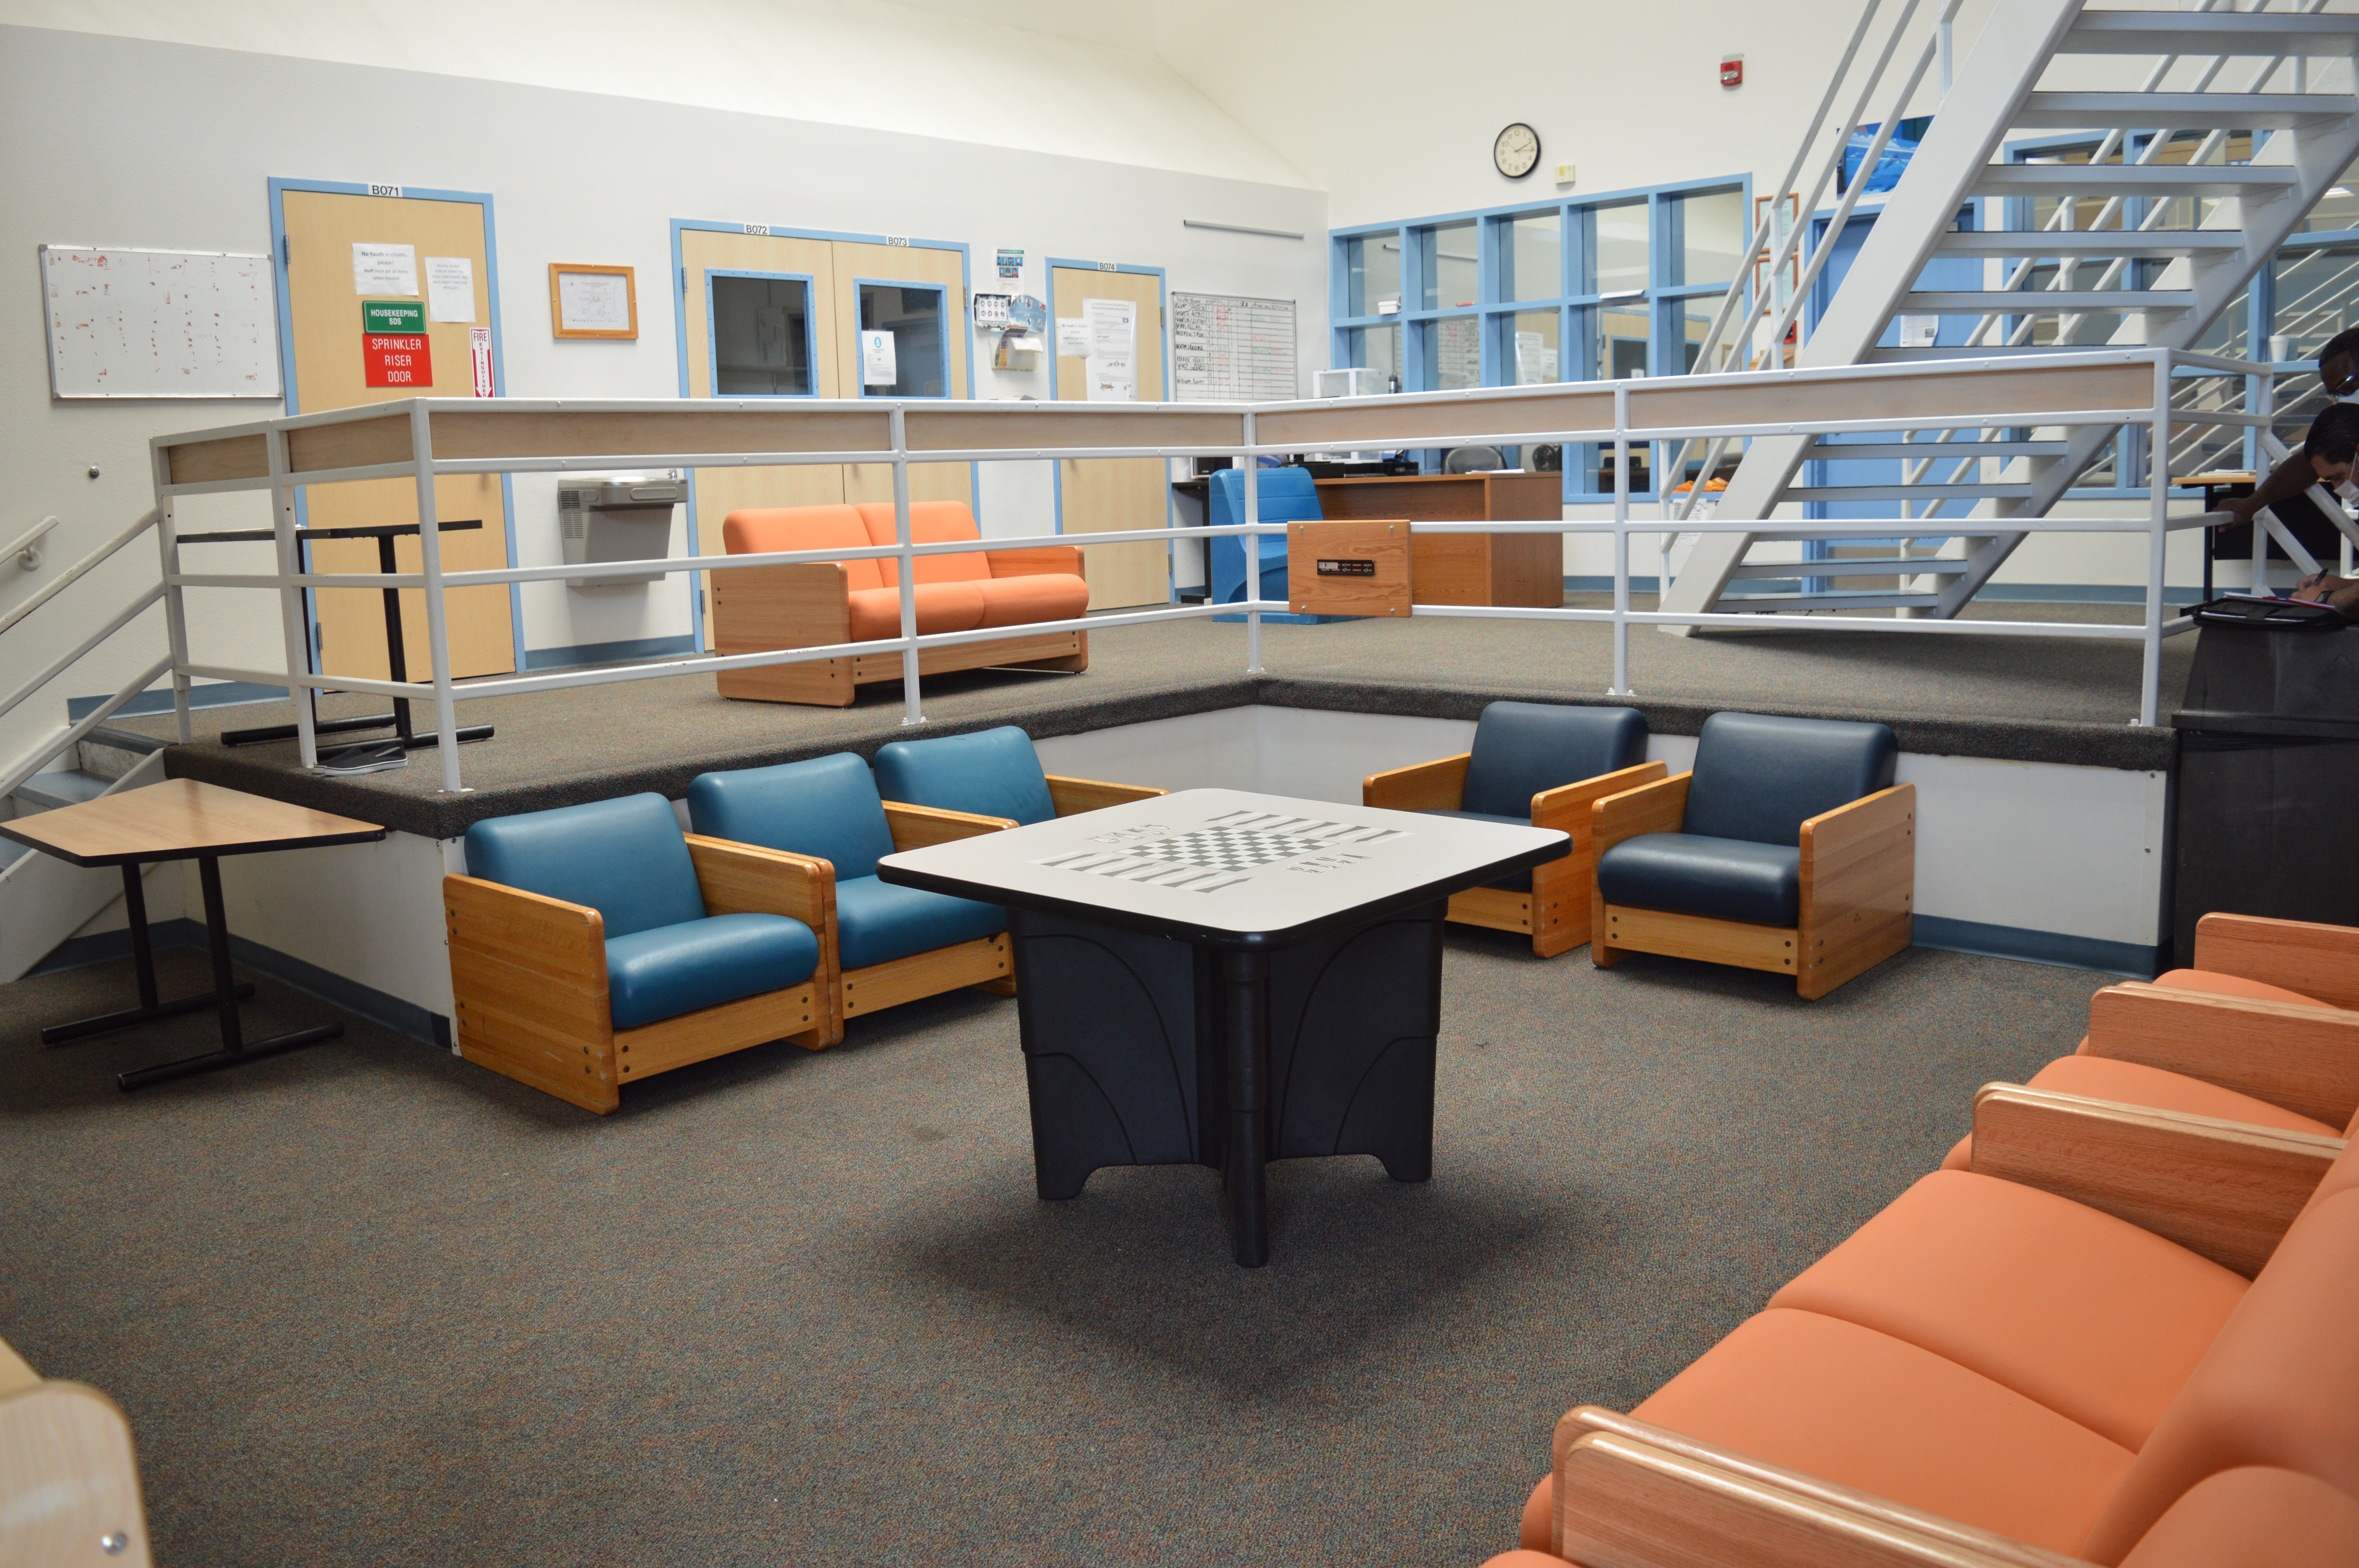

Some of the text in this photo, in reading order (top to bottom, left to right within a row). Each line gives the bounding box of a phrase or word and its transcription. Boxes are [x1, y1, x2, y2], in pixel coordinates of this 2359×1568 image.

[372, 185, 398, 196] B071
[746, 225, 767, 234] B072
[889, 237, 907, 246] B073
[473, 332, 487, 341] FIRE
[372, 339, 421, 350] SPRINKLER
[385, 355, 412, 367] RISER
